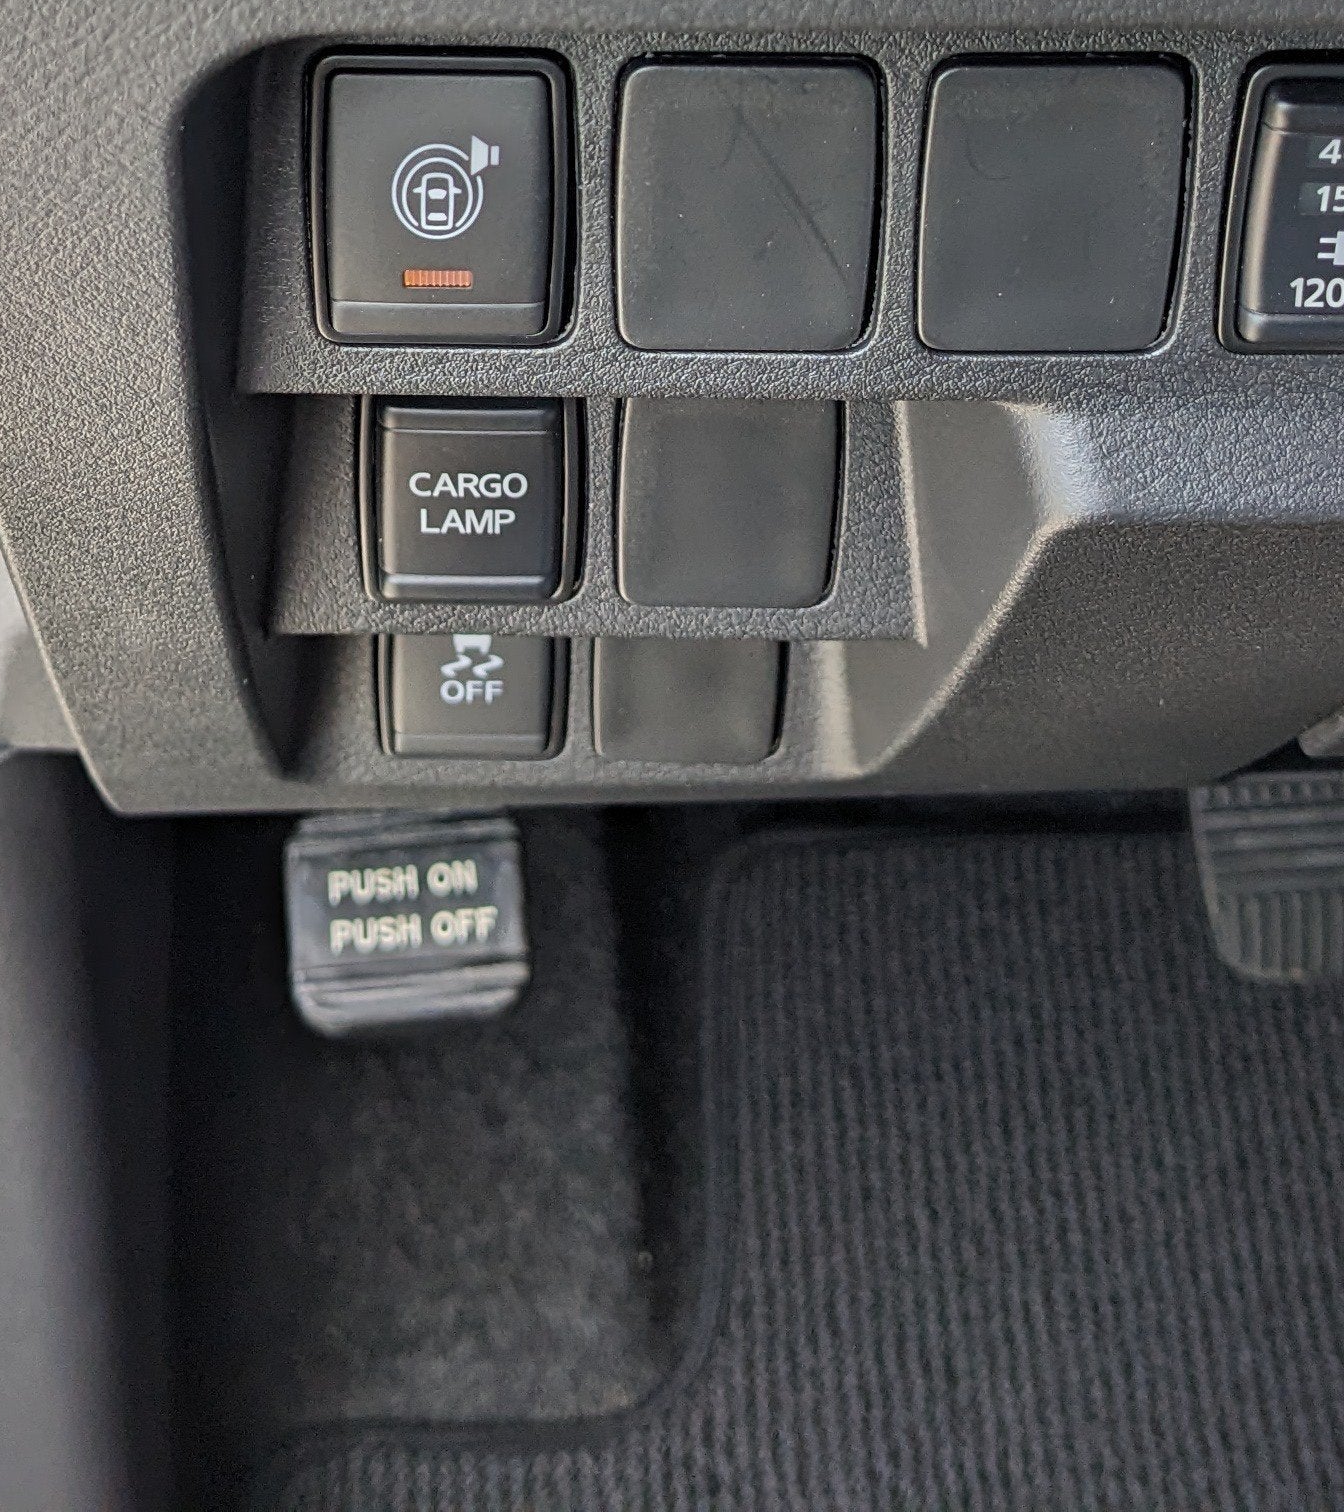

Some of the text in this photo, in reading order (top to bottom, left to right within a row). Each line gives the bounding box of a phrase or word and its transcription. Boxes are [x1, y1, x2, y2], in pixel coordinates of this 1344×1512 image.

[409, 472, 528, 499] CARGO
[420, 508, 516, 535] LAMP
[440, 679, 504, 705] OFF
[327, 859, 479, 906] PUSH ON
[329, 905, 499, 956] PUSH OFF
